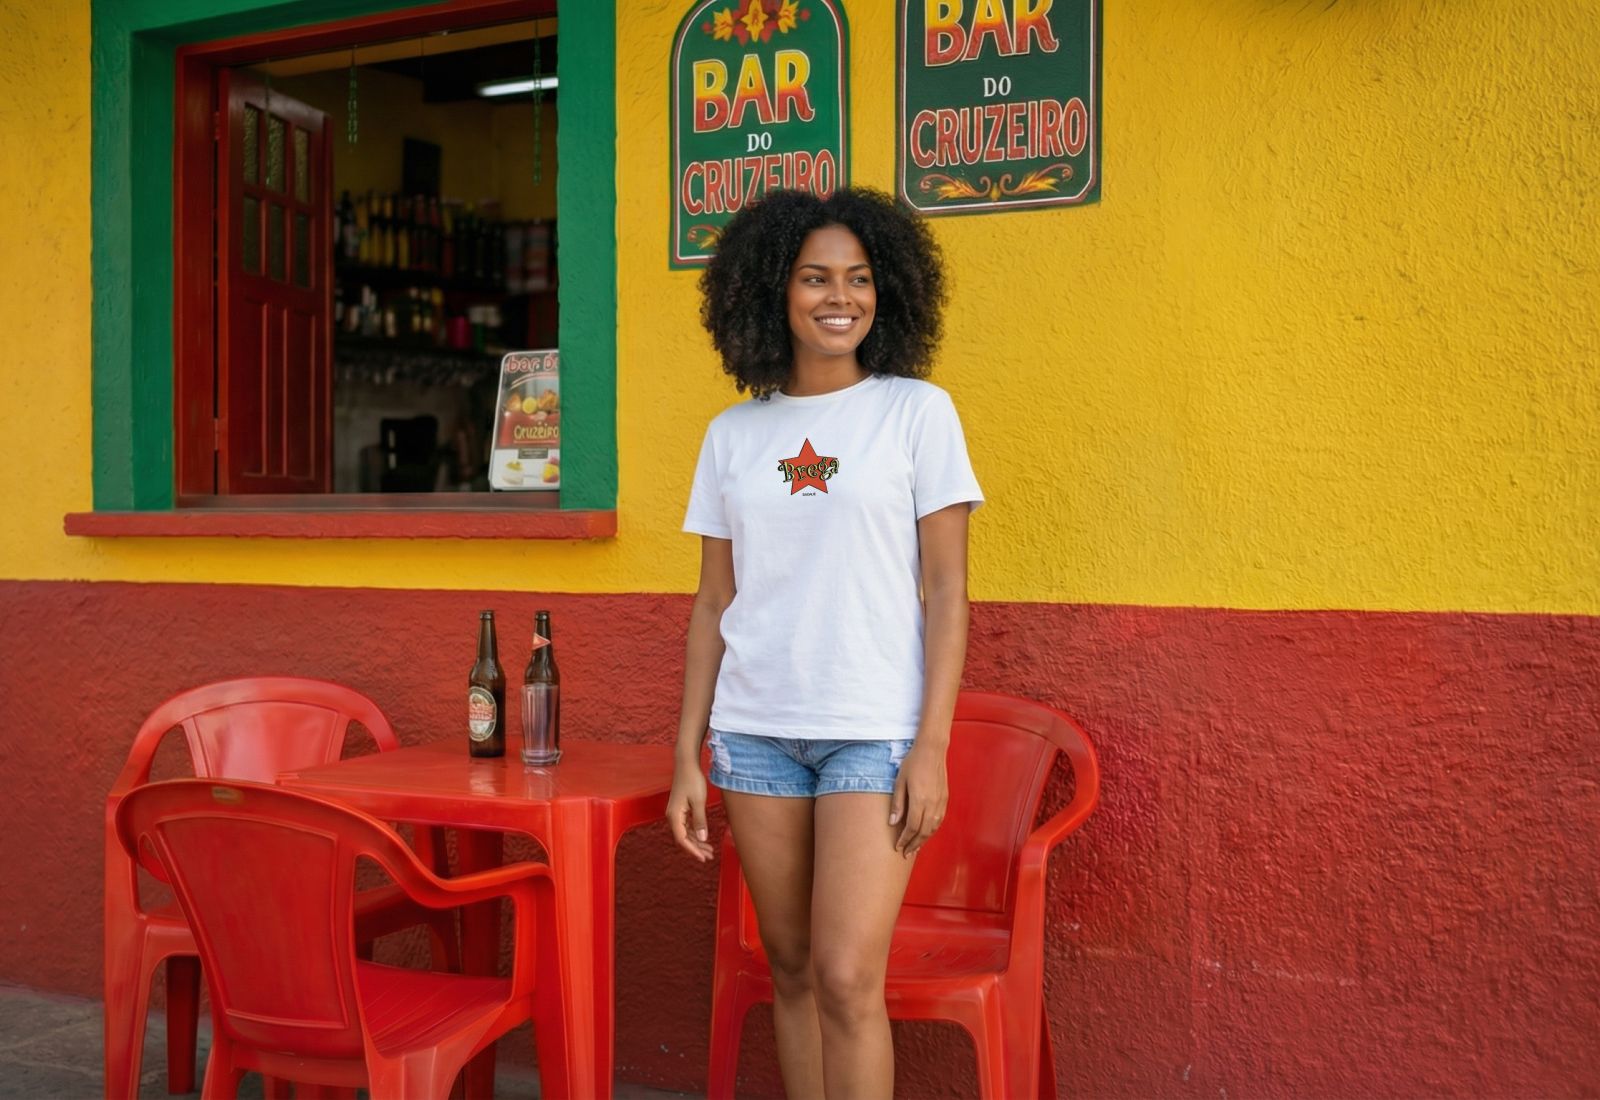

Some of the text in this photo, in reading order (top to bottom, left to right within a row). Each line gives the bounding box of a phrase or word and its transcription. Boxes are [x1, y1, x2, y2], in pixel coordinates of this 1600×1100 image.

[925, 0, 1059, 67] BAR
[692, 49, 815, 133] BAR
[983, 76, 1012, 97] DO
[747, 132, 773, 152] DO
[910, 97, 1088, 168] CRUZEIRO
[778, 457, 840, 483] Brega
